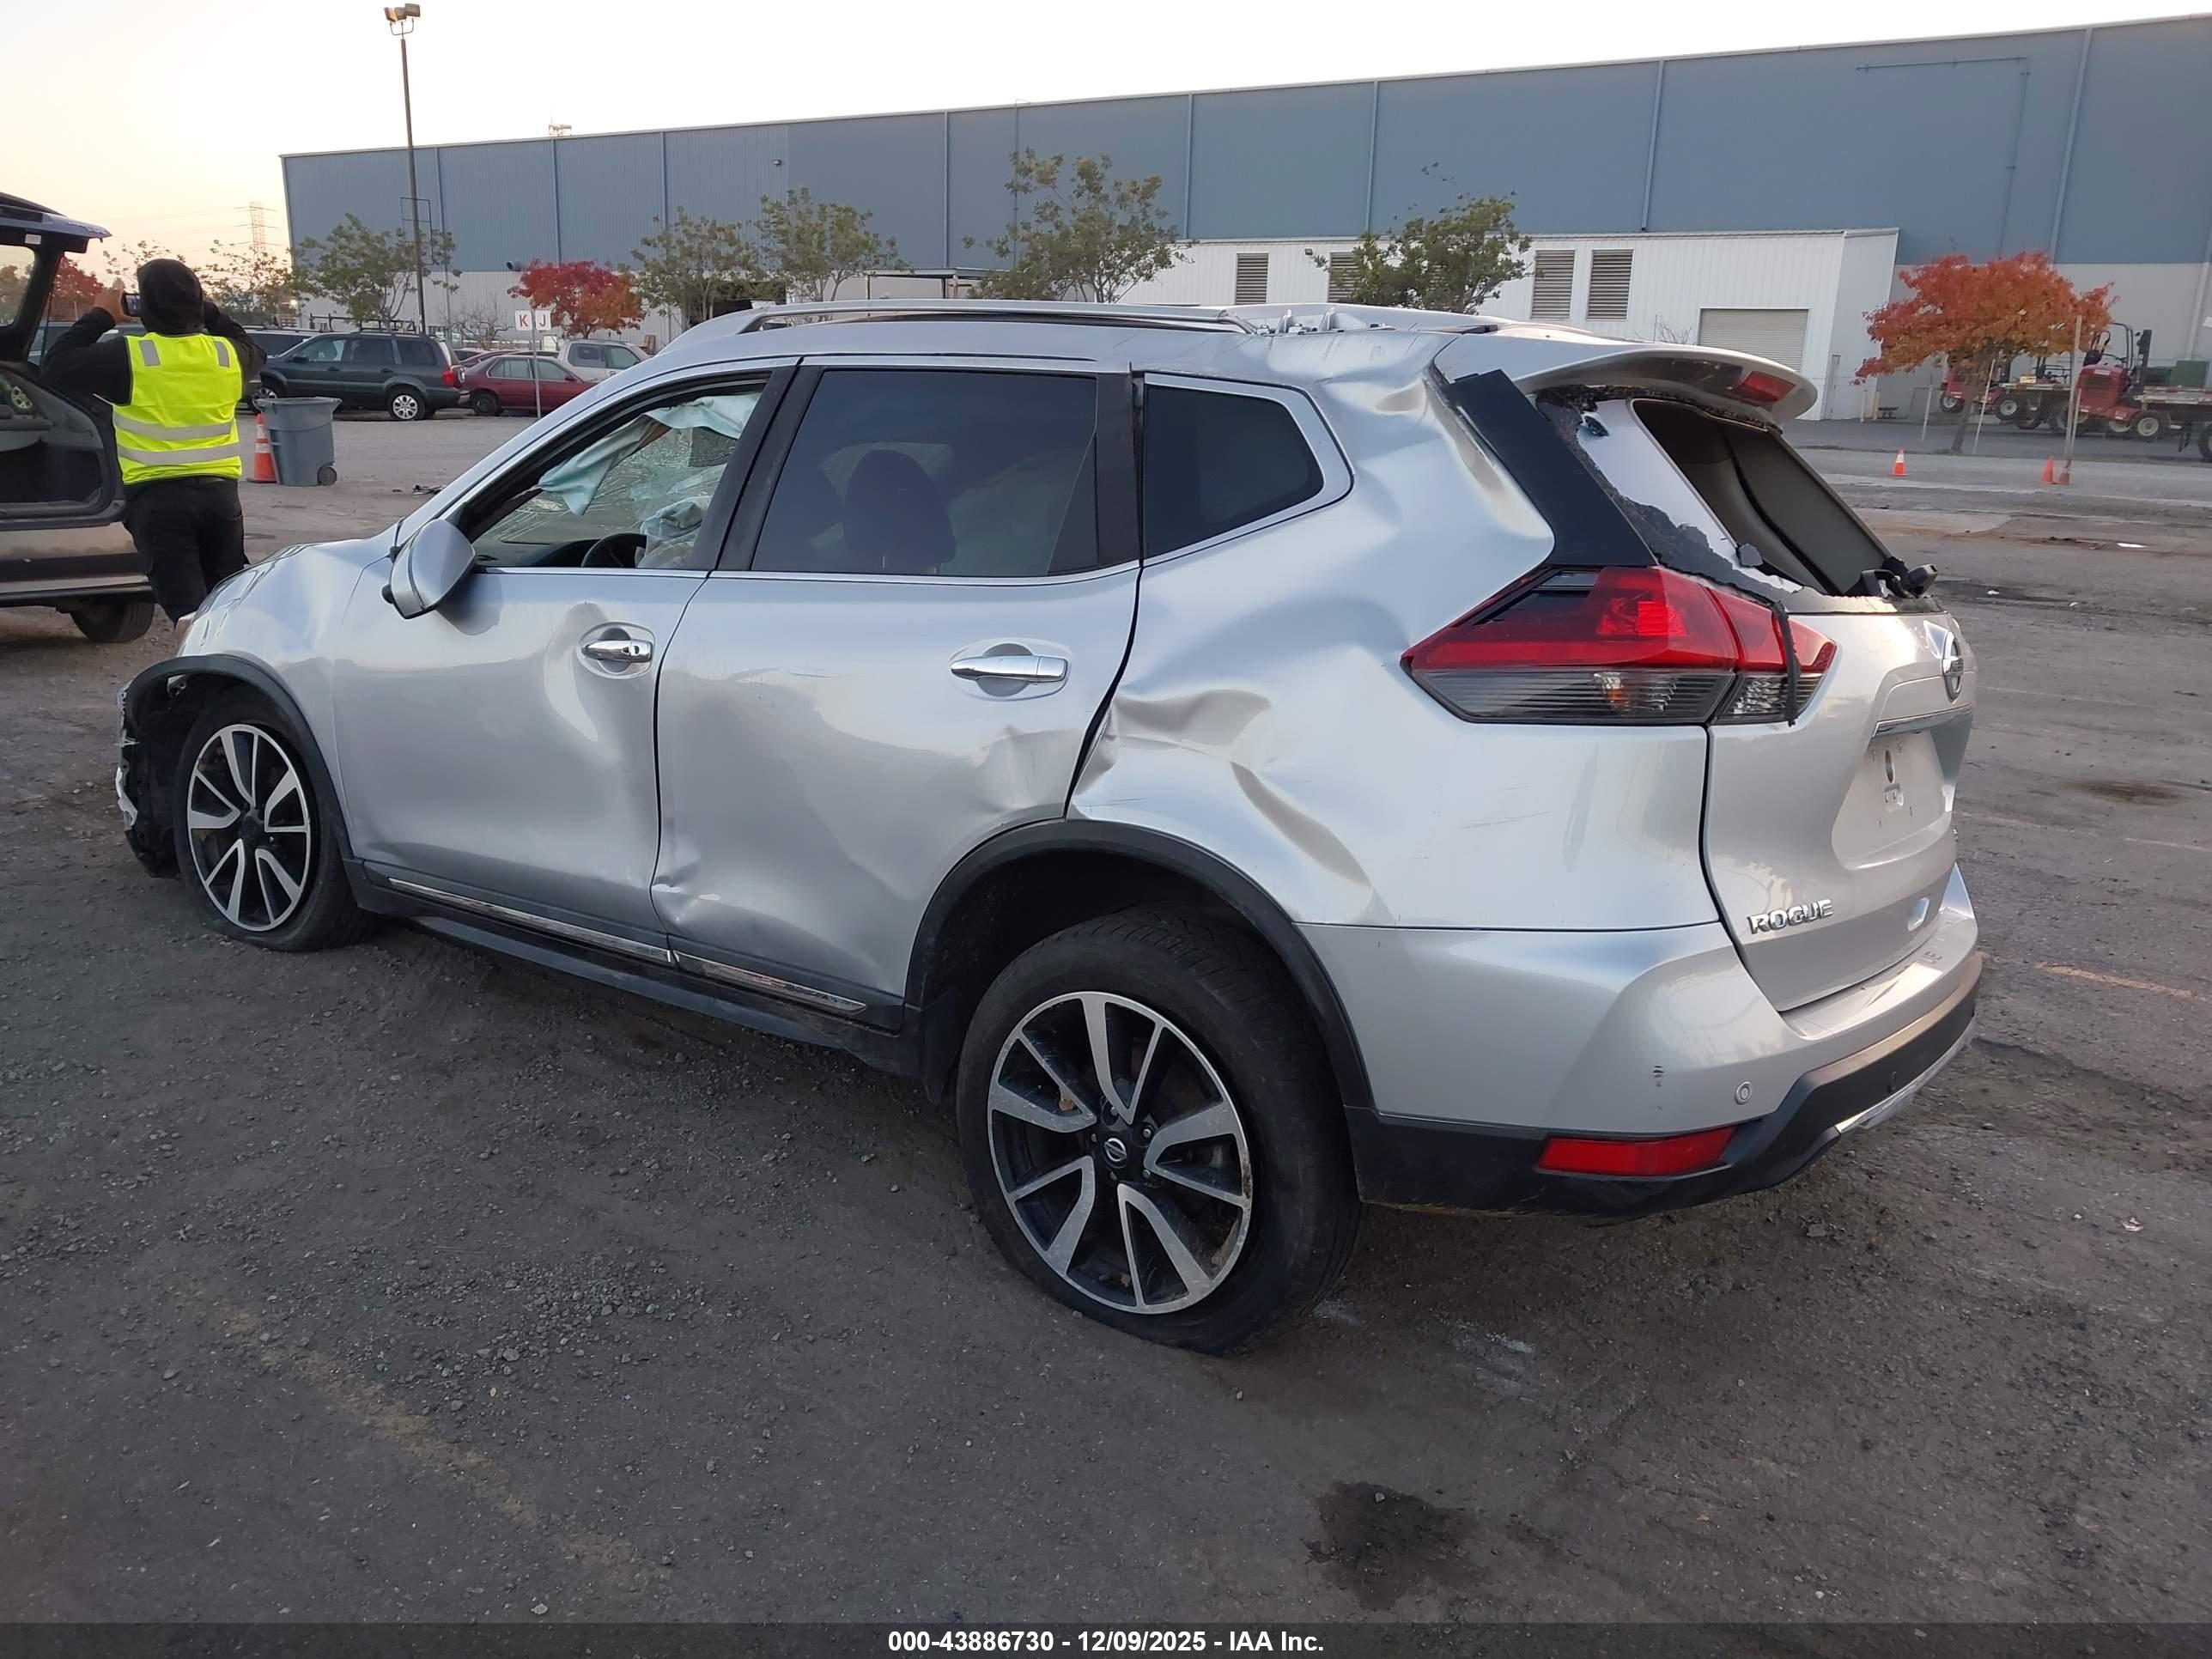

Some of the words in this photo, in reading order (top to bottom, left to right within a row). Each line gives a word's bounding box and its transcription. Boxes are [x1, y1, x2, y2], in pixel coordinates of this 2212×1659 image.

[519, 314, 528, 327] K
[539, 314, 546, 327] J
[1747, 899, 1833, 934] ROGUE
